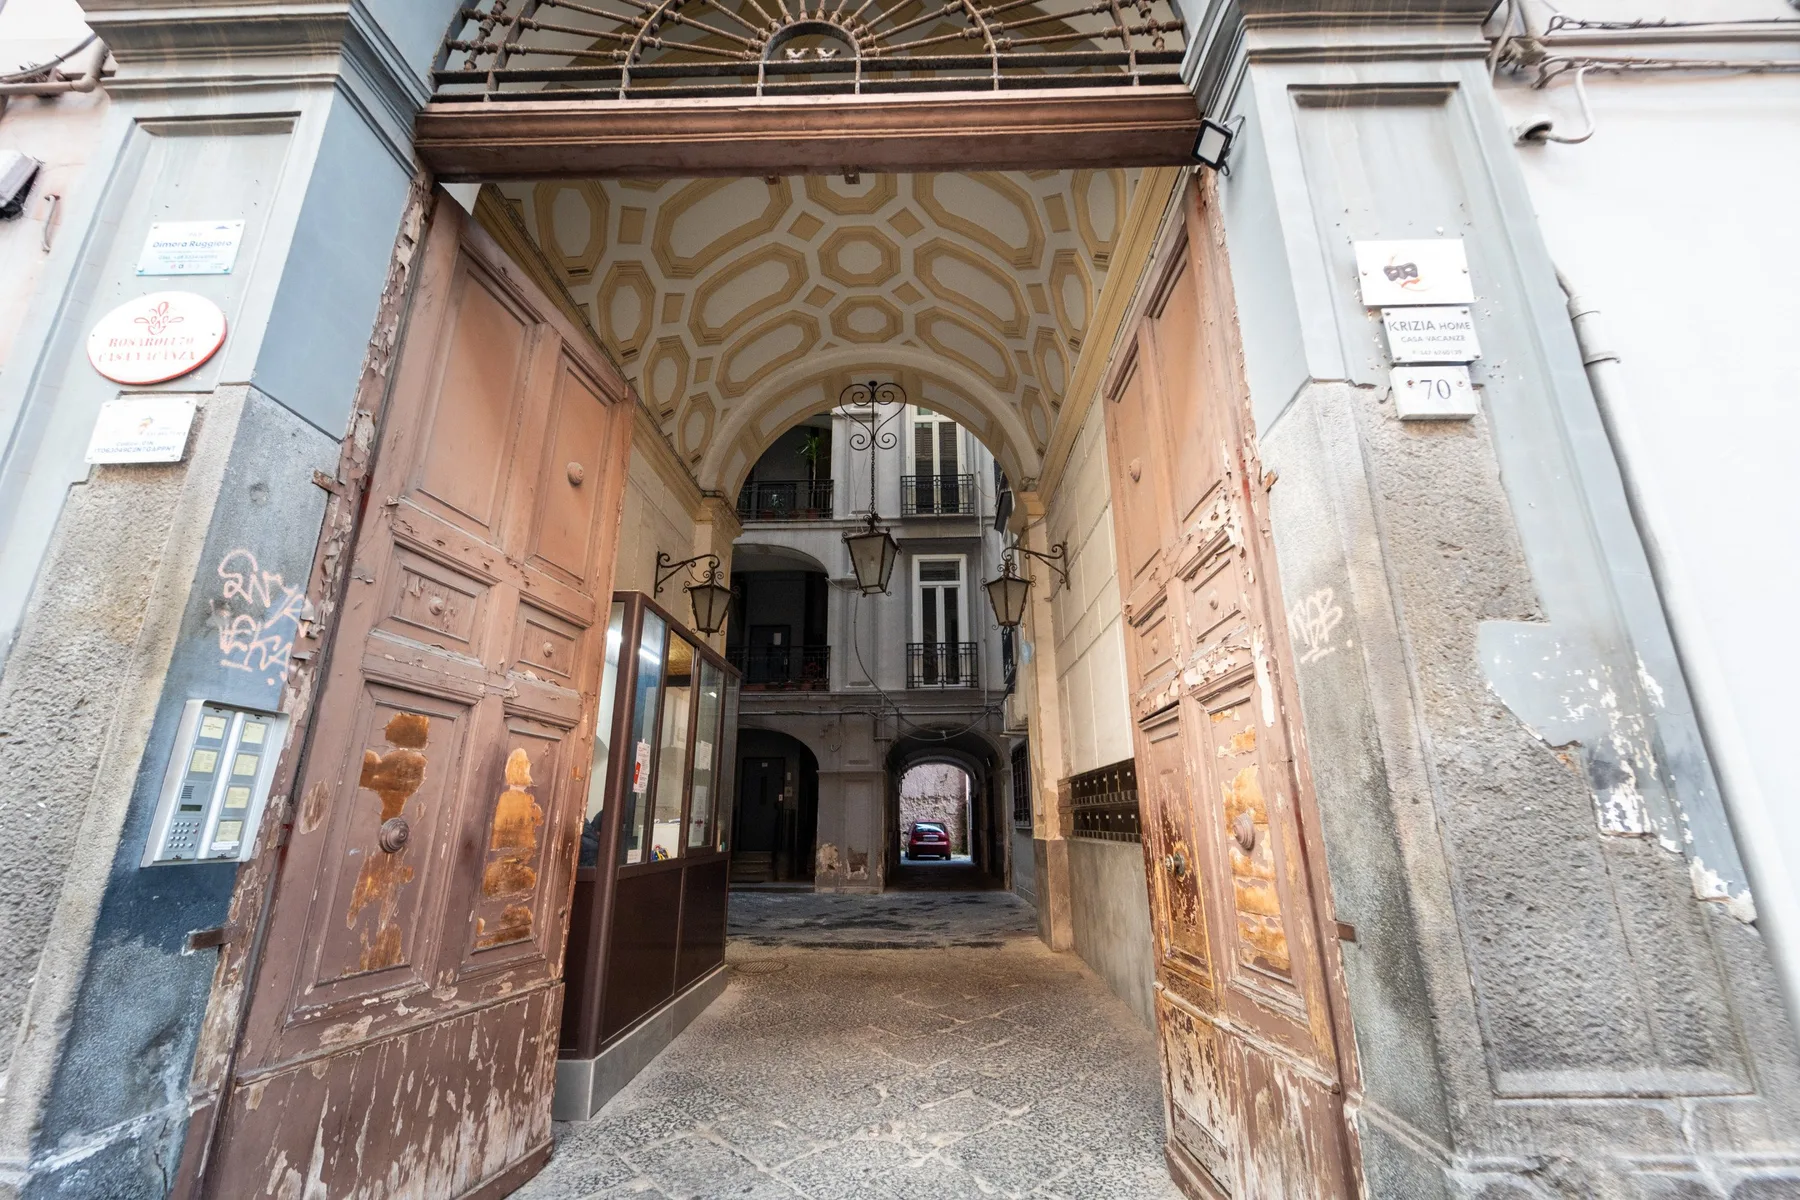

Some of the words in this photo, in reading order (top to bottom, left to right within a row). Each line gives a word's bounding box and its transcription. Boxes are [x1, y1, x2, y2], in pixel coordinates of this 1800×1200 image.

[189, 240, 233, 249] Ruggiero
[1388, 320, 1436, 331] KRIZIA
[1438, 321, 1471, 331] HOME
[1419, 378, 1452, 400] 70
